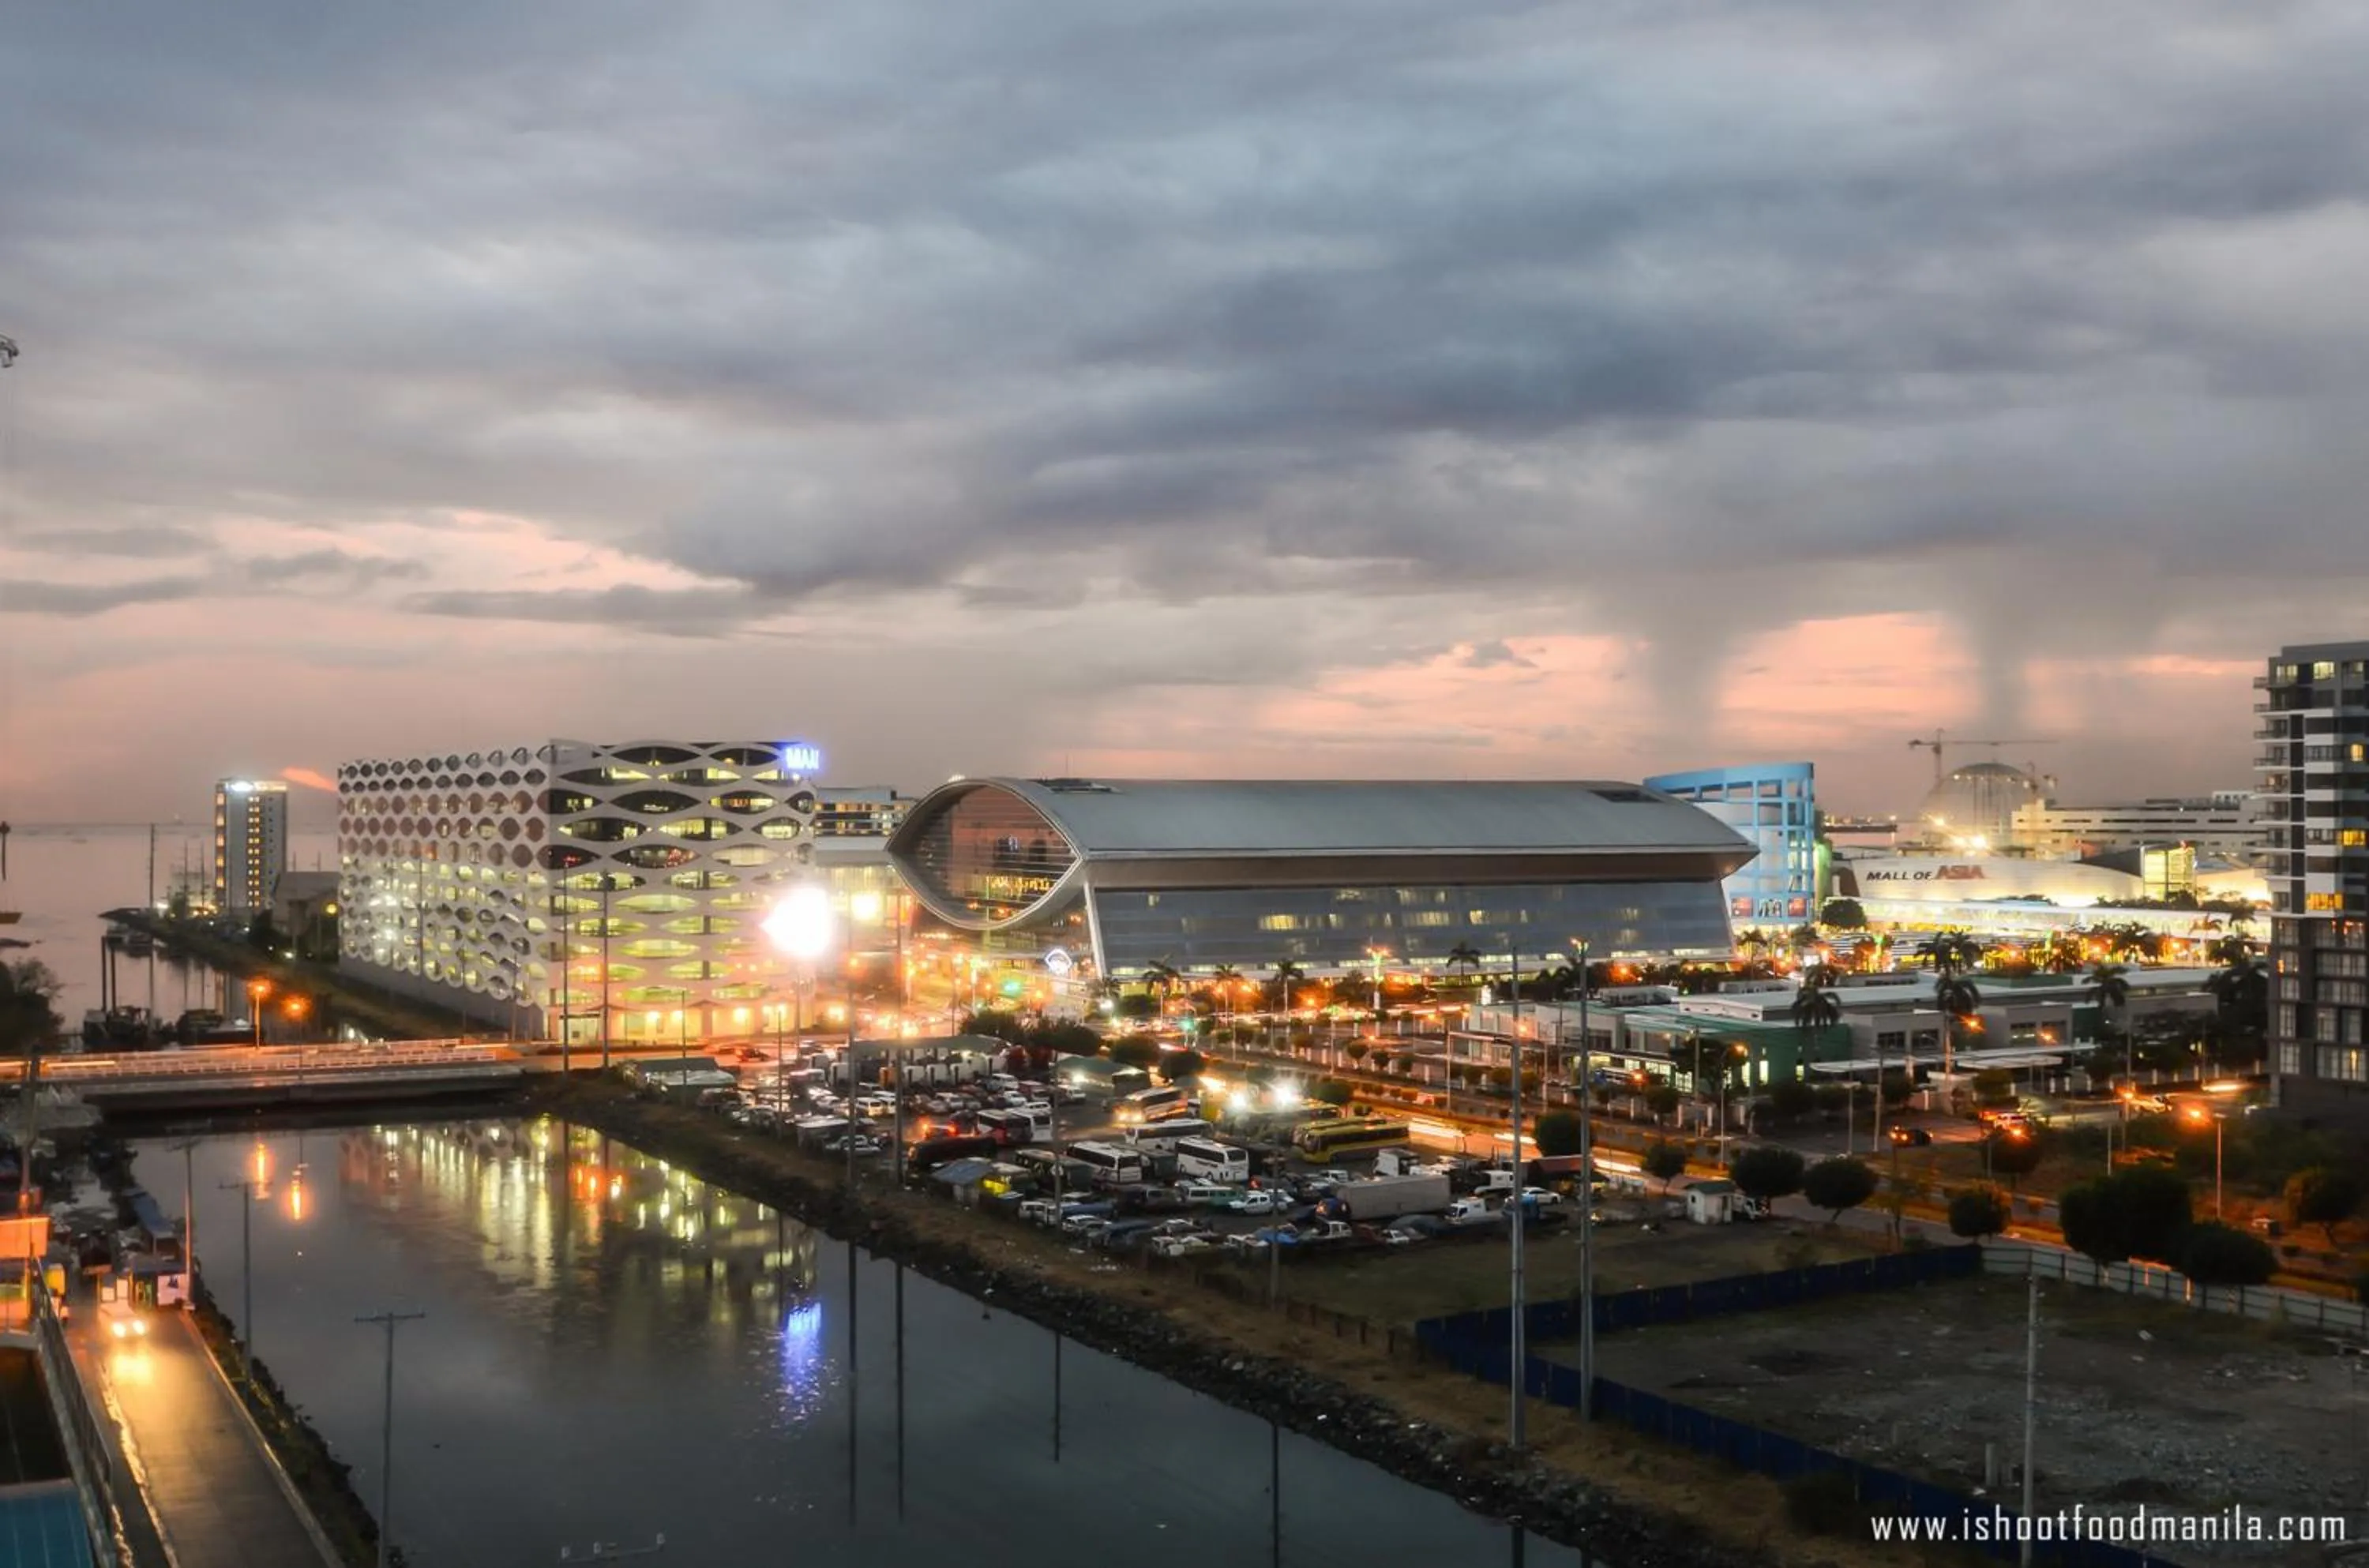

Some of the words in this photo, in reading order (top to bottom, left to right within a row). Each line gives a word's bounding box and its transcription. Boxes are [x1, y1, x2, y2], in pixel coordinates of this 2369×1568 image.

[1865, 871, 1909, 881] MALL
[1913, 871, 1932, 880] OF
[1934, 865, 1985, 880] ASIA
